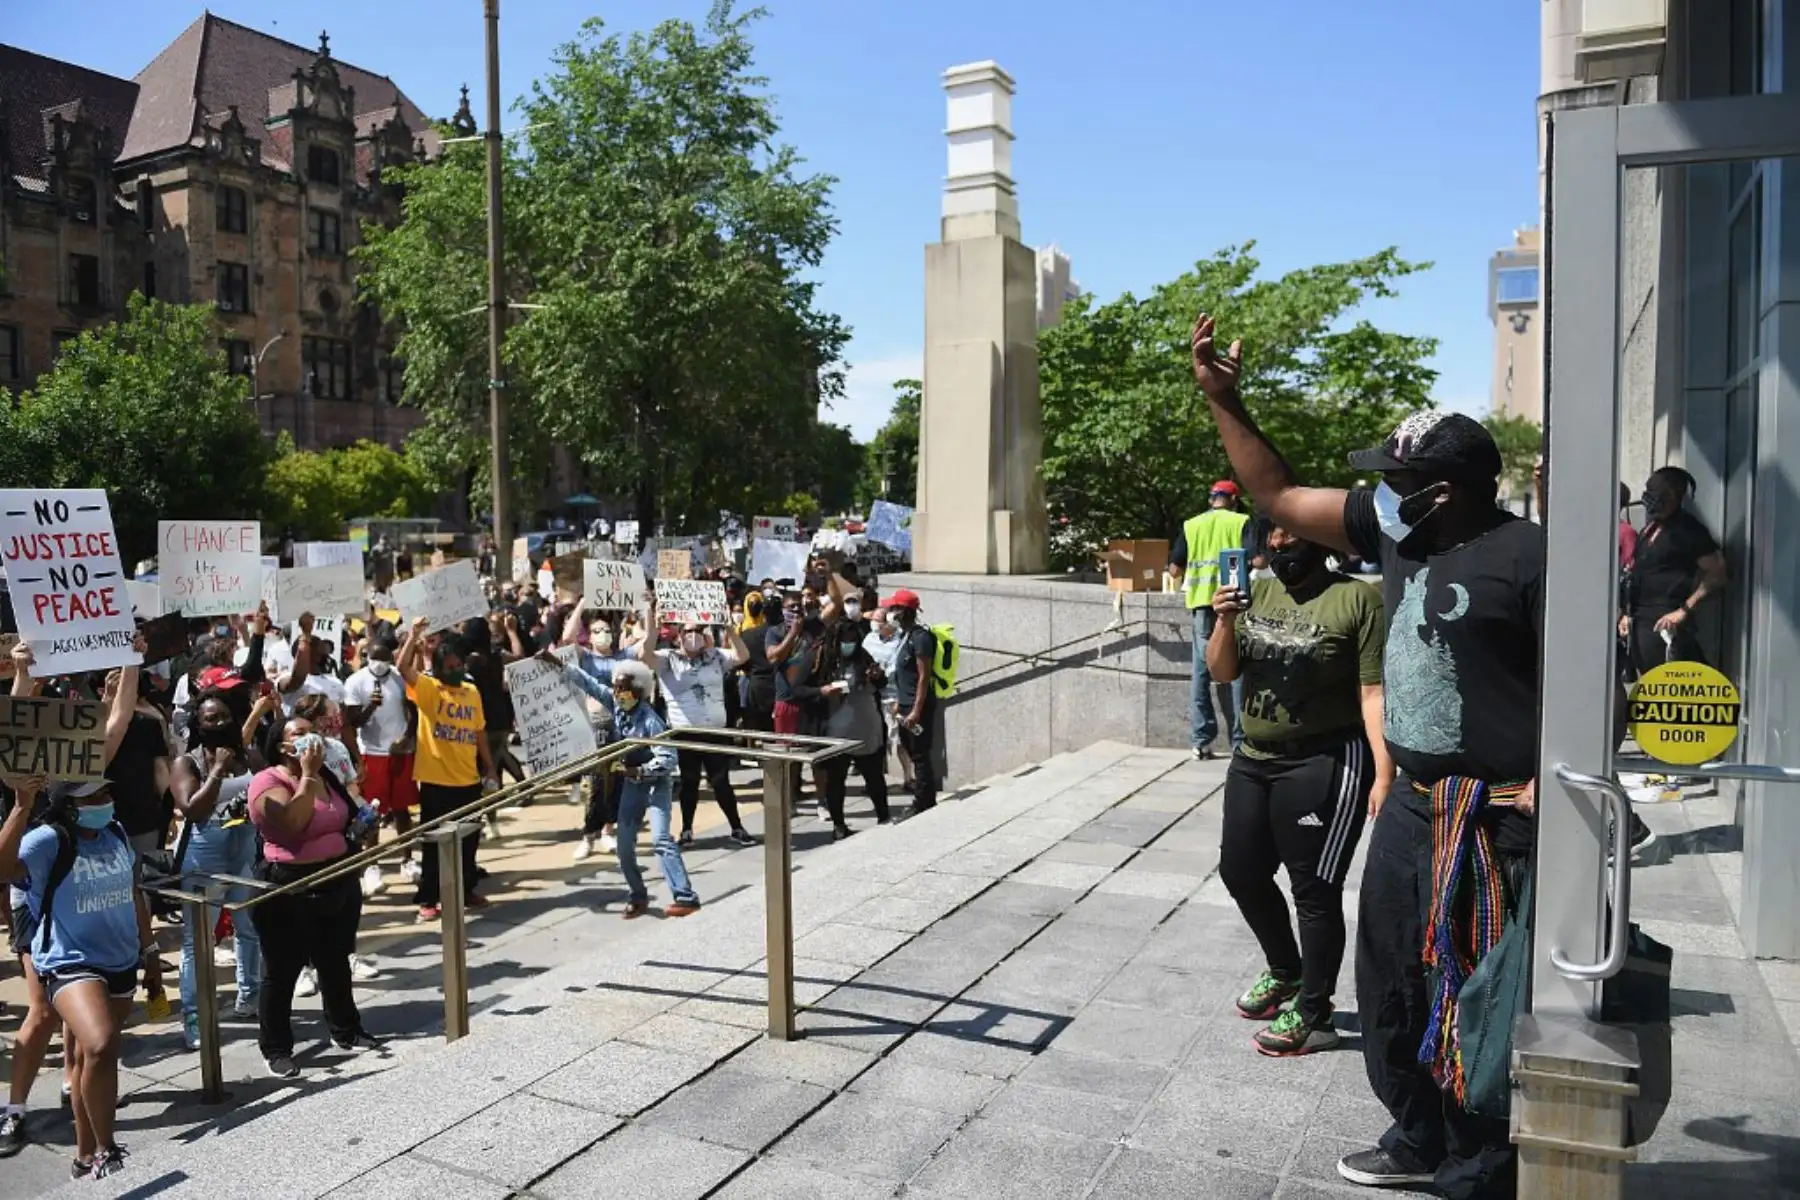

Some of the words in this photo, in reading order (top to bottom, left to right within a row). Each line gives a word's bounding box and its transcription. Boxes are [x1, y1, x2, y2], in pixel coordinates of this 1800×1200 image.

[34, 499, 69, 525] NO
[5, 533, 114, 560] JUSTICE
[166, 526, 254, 553] CHANGE
[49, 564, 88, 590] NO
[195, 560, 216, 573] the
[597, 562, 632, 579] SKIN
[175, 574, 243, 595] SYSTEM
[611, 580, 621, 591] IS
[33, 588, 120, 625] PEACE
[594, 589, 634, 607] SKIN
[1637, 683, 1732, 698] AUTOMATIC
[59, 703, 97, 730] US
[1631, 702, 1734, 723] CAUTION
[1660, 729, 1706, 742] DOOR
